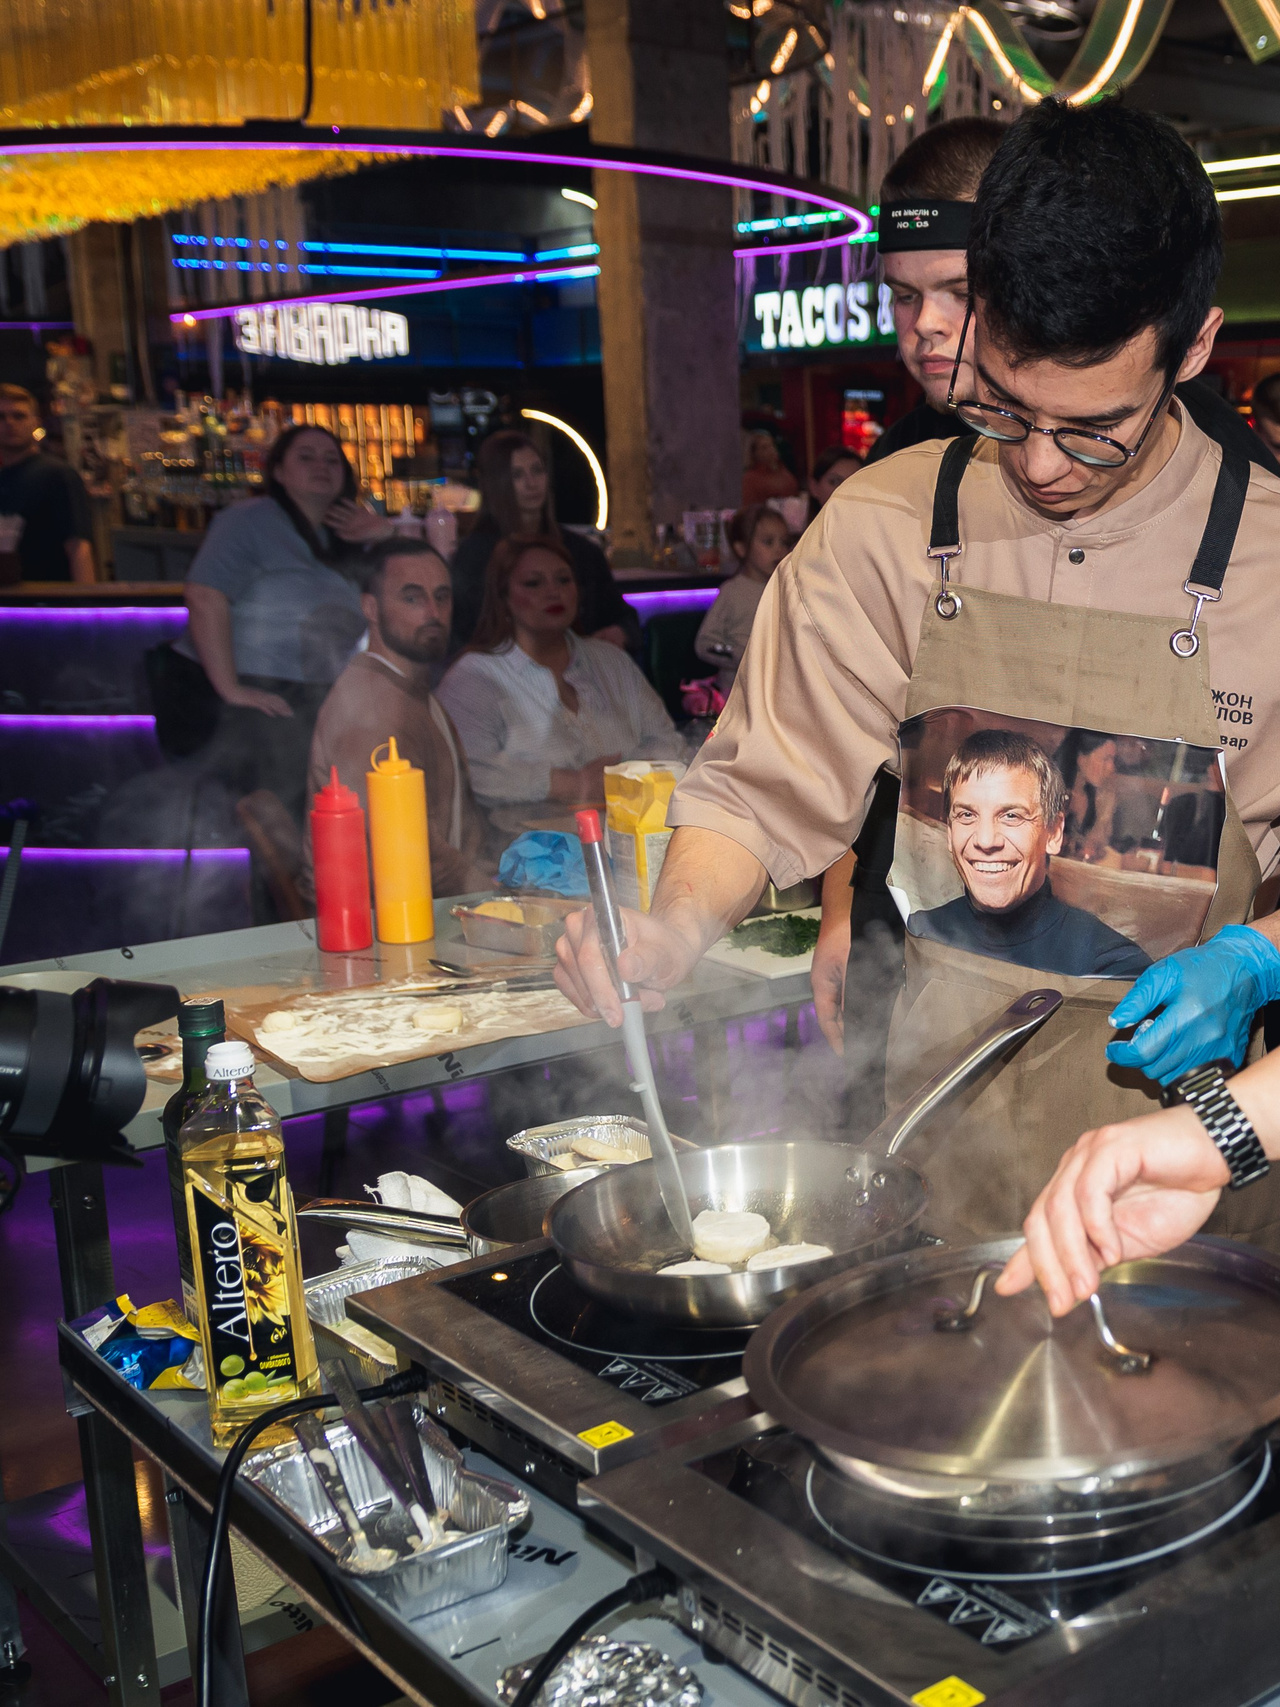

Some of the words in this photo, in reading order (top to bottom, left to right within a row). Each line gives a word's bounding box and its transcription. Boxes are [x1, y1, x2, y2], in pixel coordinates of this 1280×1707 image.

[754, 281, 871, 350] TACOS
[1214, 705, 1254, 725] ЛОВ
[212, 1065, 250, 1078] Altero
[211, 1221, 250, 1342] Altero
